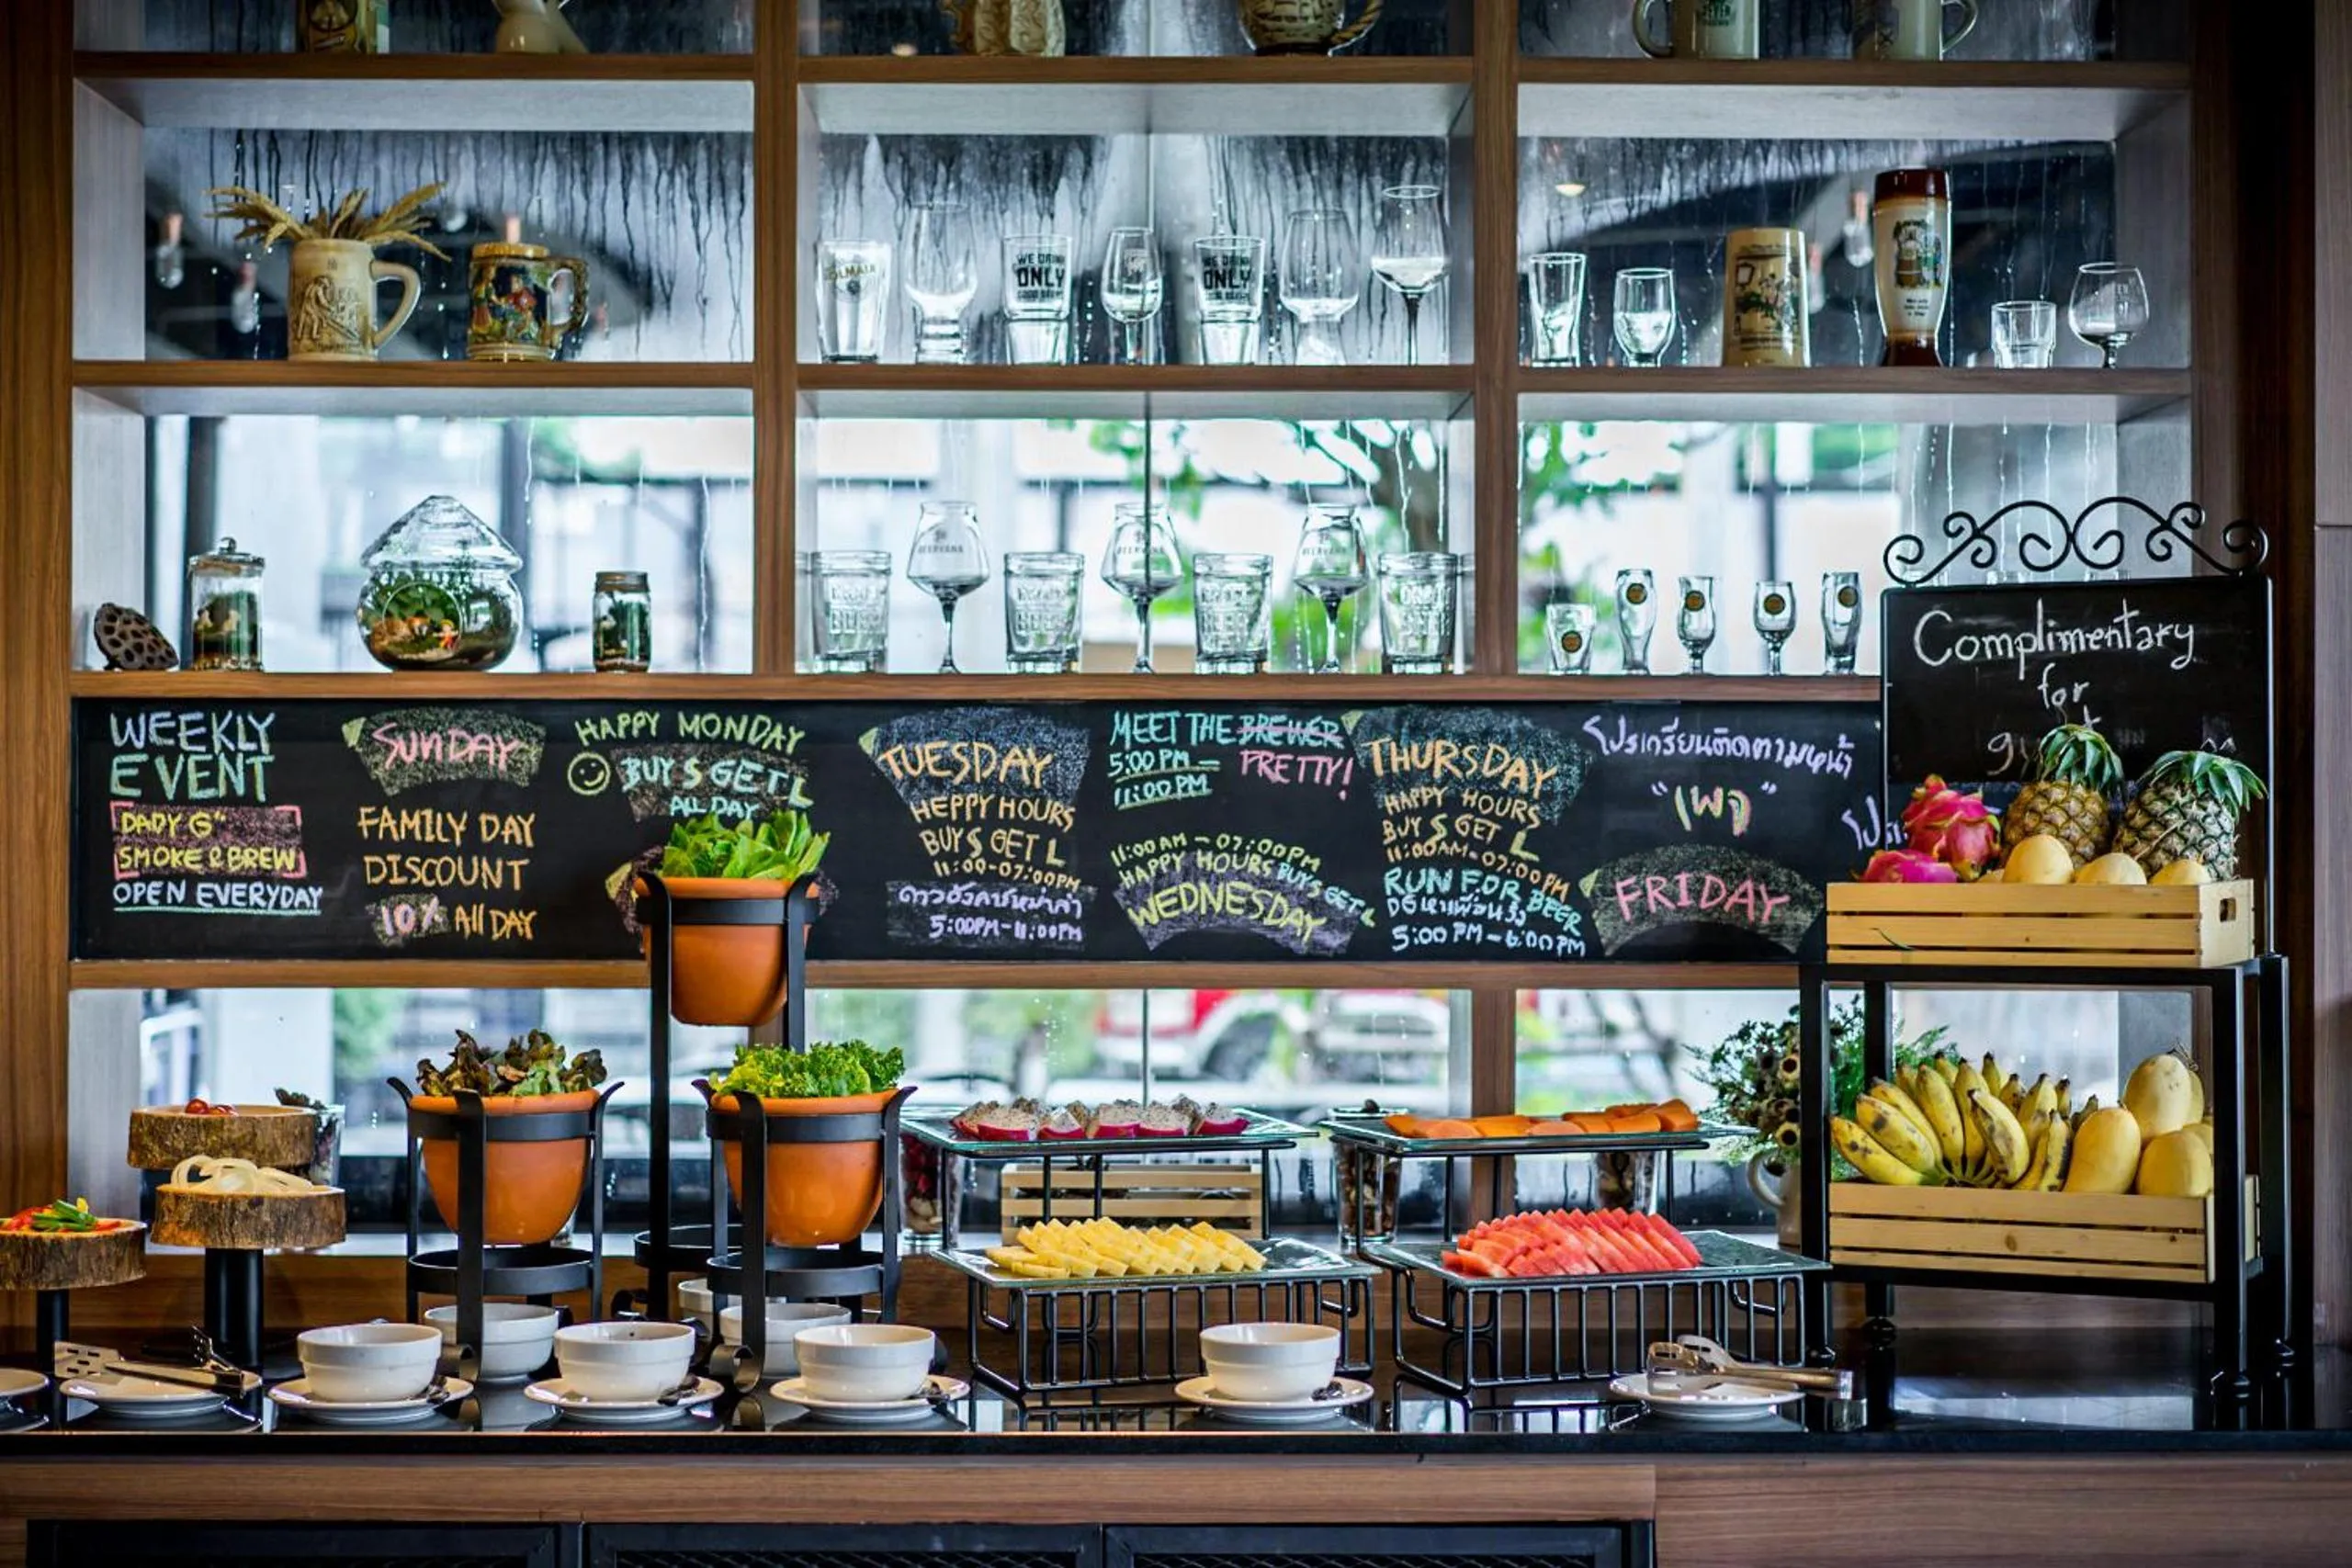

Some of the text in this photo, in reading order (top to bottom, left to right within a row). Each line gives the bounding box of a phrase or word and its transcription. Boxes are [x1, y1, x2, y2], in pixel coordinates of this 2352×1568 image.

[1016, 266, 1066, 288] ONLY
[1204, 267, 1251, 289] ONLY
[1914, 597, 2195, 681] Complimentary
[2037, 662, 2090, 709] for
[109, 710, 276, 755] WEEKLY
[575, 711, 805, 755] HAPPY MONDAY
[1109, 710, 1345, 750] MEET THE BREWER
[109, 752, 275, 803] EVENT
[620, 755, 675, 794] BUY
[709, 757, 789, 795] GET
[877, 739, 1054, 789] TUESDAY
[1107, 750, 1155, 778] 5:00
[1160, 749, 1191, 771] PM
[1240, 749, 1353, 801] PRETTY!
[1360, 736, 1558, 800] THURSDAY
[669, 795, 760, 821] ALL DAY
[1114, 773, 1210, 807] 11:00 PM
[1385, 785, 1542, 829] HAPPY HOURS
[119, 811, 182, 838] DADY
[357, 805, 537, 848] FAMILY DAY
[910, 793, 1076, 833] HEPPY HOURS
[1383, 815, 1423, 844] BUY
[1454, 814, 1502, 844] GET
[119, 846, 298, 875] SMOKE & BREW
[919, 825, 964, 857] BUY
[990, 829, 1040, 862] GET
[363, 853, 531, 891] DISCOUNT
[1118, 851, 1186, 889] HAPPY
[1197, 849, 1275, 877] HOURS
[1276, 862, 1315, 890] BUY
[1324, 886, 1366, 914] GET
[112, 879, 324, 909] OPEN EVERYDAY
[1127, 879, 1328, 945] WEDNESDAY
[1384, 866, 1583, 937] RUN FOR BEER
[1614, 871, 1791, 925] FRIDAY
[380, 895, 446, 937] 10%
[489, 908, 538, 941] DAY
[1391, 924, 1448, 953] 5:00
[1453, 921, 1484, 944] PM
[1505, 929, 1553, 952] 6:00
[1555, 934, 1586, 958] PM
